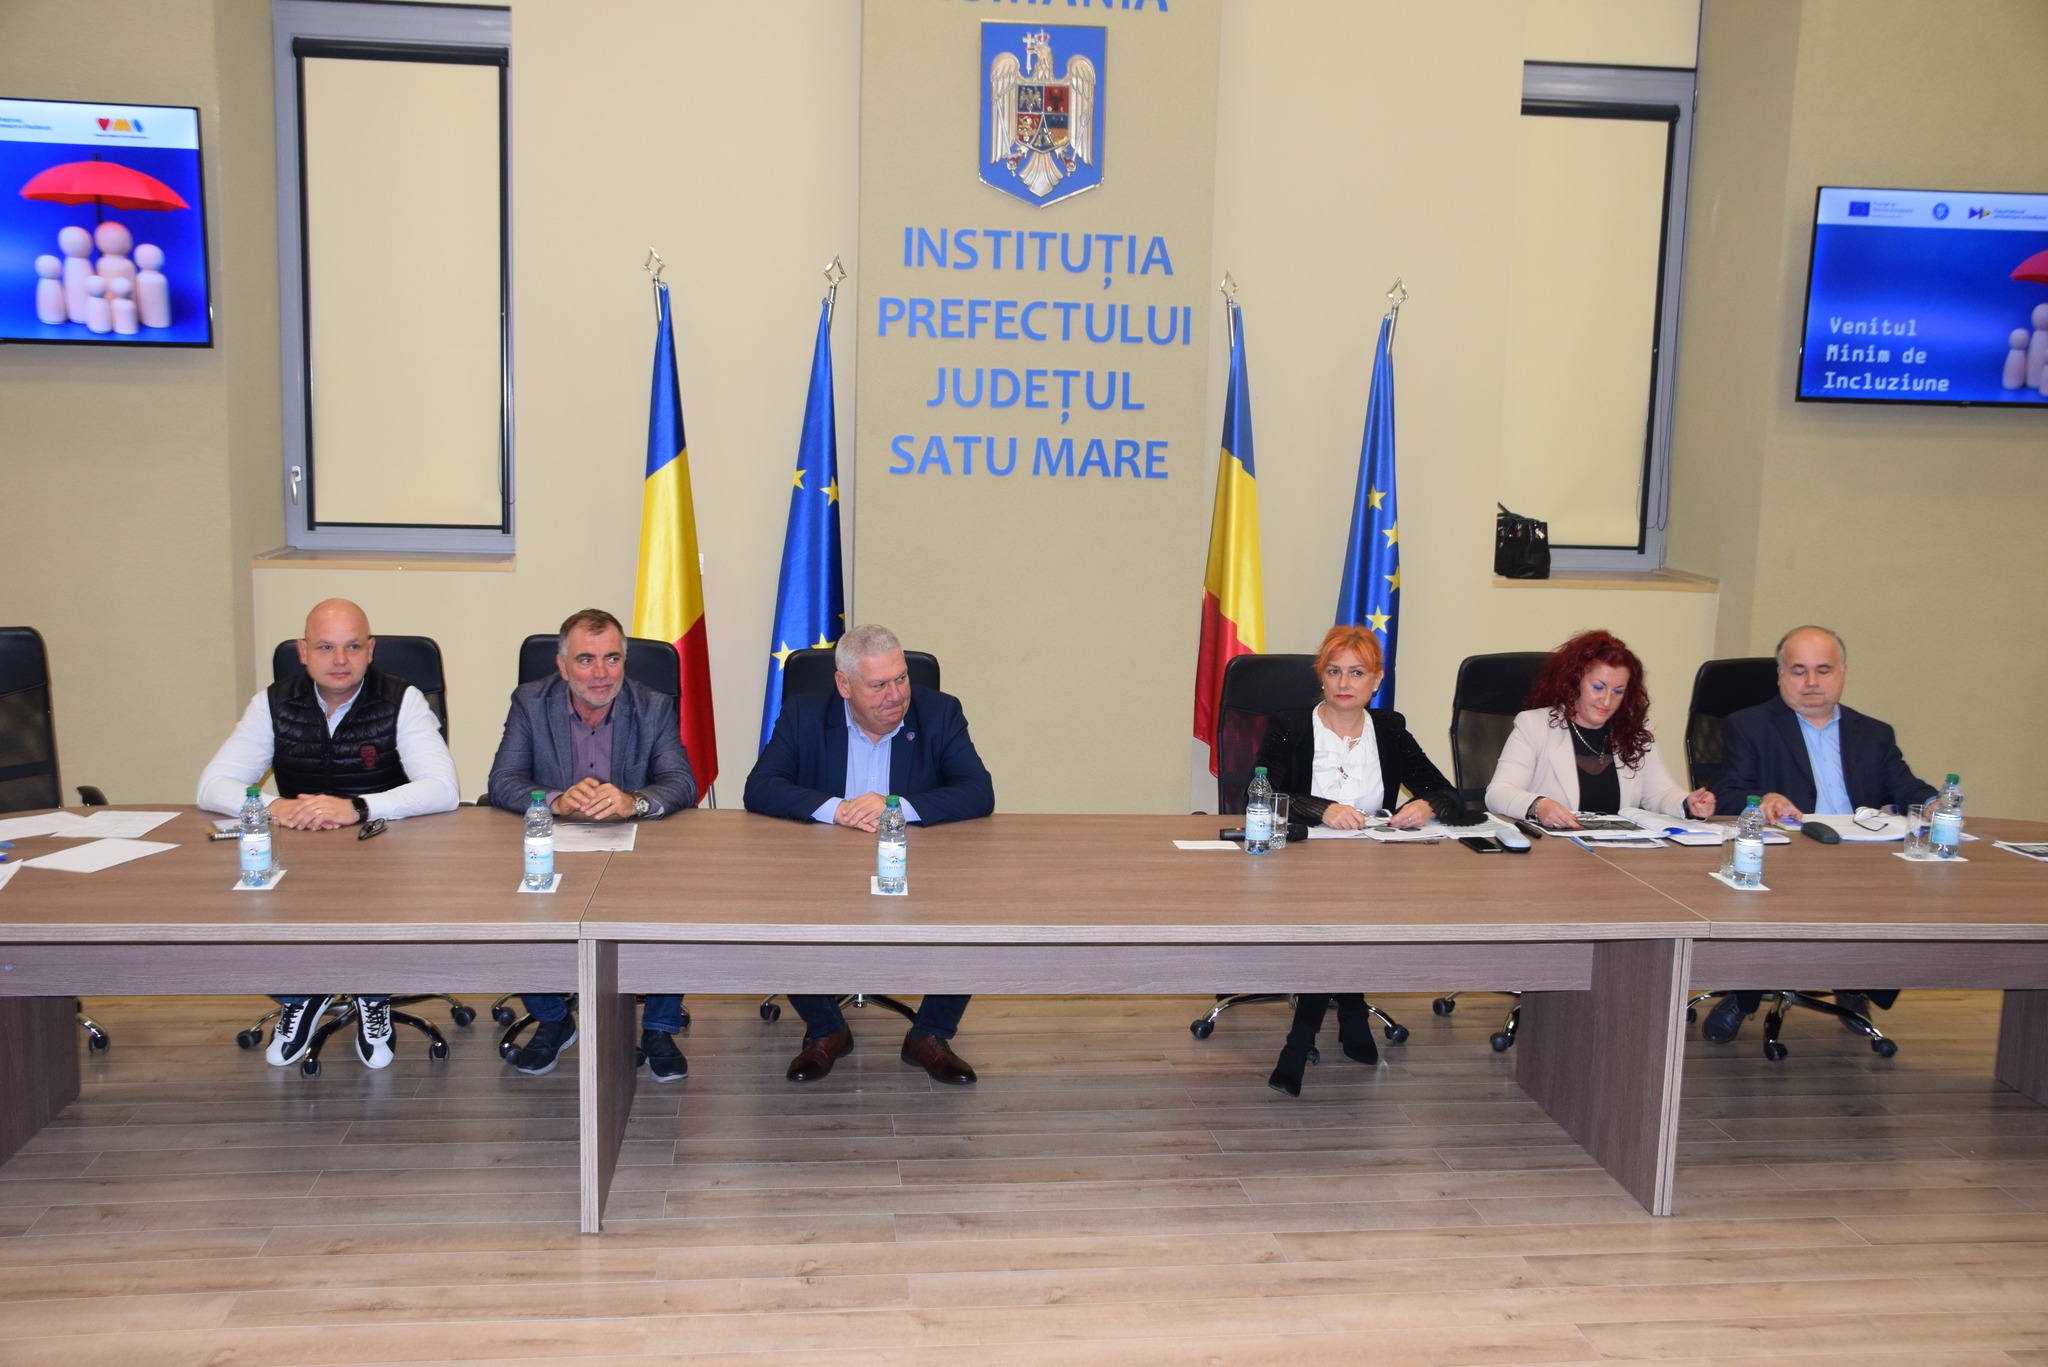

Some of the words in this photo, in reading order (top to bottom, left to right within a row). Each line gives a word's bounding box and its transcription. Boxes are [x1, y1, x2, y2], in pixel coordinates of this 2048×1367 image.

[877, 296, 1192, 346] PREFECTULUI
[1829, 316, 1917, 337] Venitul
[1826, 344, 1890, 364] Minim
[1902, 346, 1927, 364] de
[1823, 371, 1950, 392] Incluziune
[888, 434, 1018, 477] SATU
[1031, 436, 1169, 480] MARE
